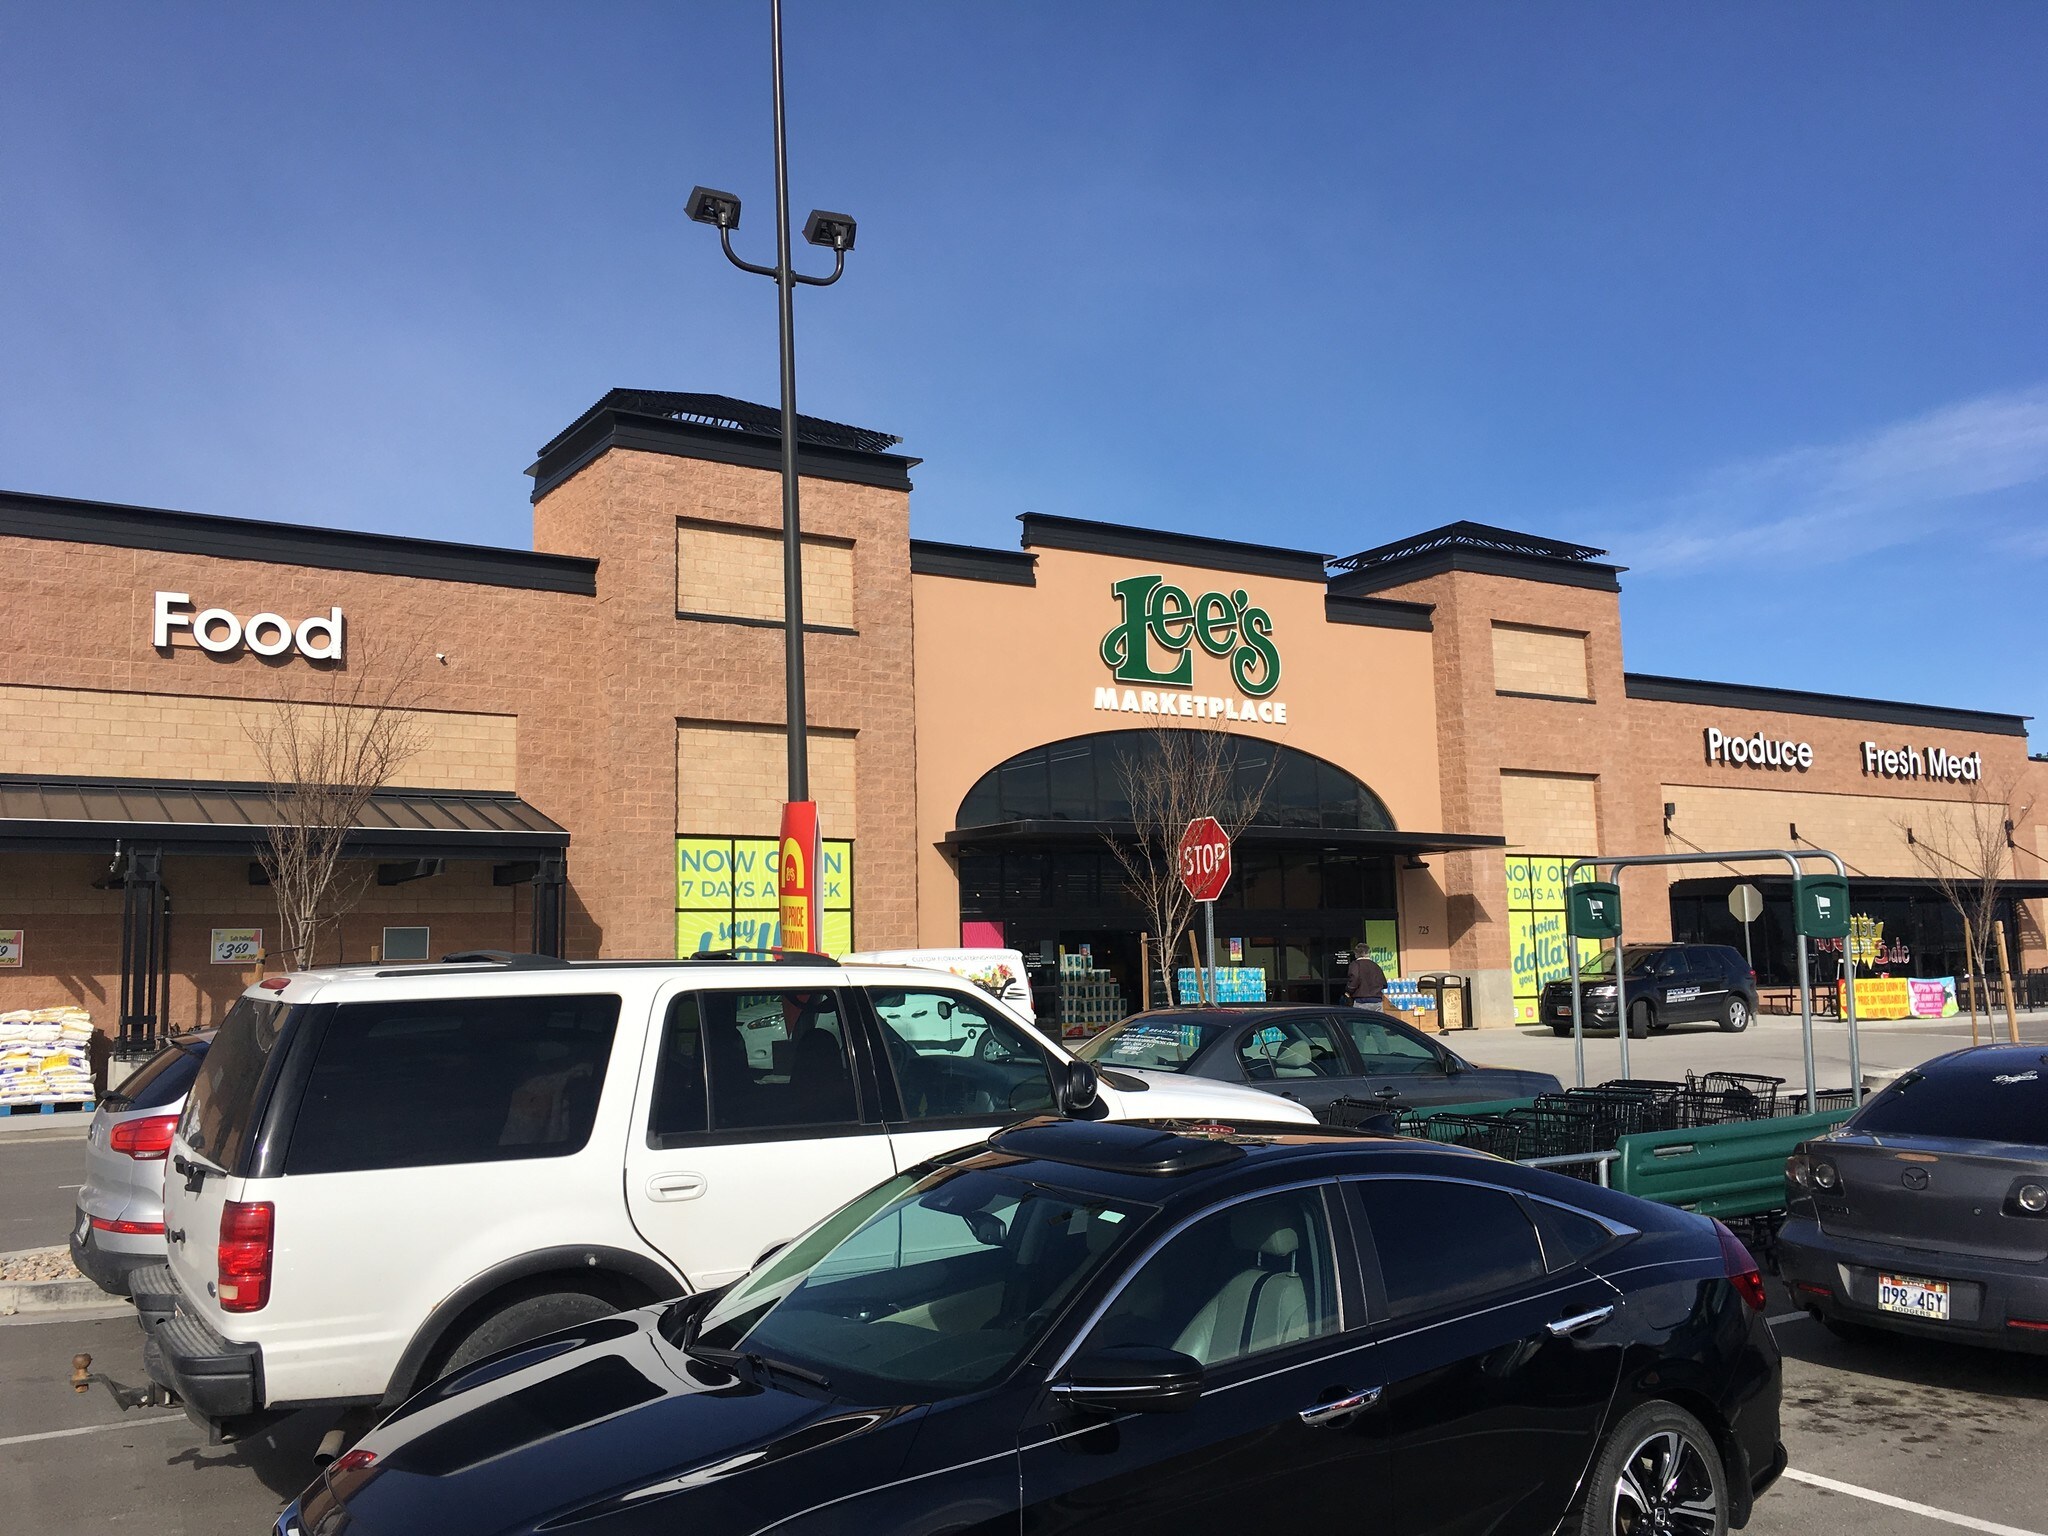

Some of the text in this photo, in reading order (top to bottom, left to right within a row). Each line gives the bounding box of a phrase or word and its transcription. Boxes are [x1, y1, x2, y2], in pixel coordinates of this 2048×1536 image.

[154, 591, 343, 661] Food
[1101, 574, 1282, 696] Lee's
[1094, 686, 1288, 725] MARKETPLACE
[1707, 727, 1814, 769] Produce
[1863, 741, 1982, 781] Fresh Meat
[681, 849, 842, 874] NOW ON
[1184, 842, 1226, 876] STOP
[1506, 865, 1542, 881] NOW
[681, 881, 694, 897] 7
[701, 881, 755, 897] DAYS
[761, 881, 776, 898] A
[1513, 887, 1544, 900] DAYS
[1546, 888, 1555, 900] A
[718, 919, 759, 942] say
[1418, 925, 1430, 935] 725
[1521, 915, 1560, 939] 1 point
[1850, 921, 1877, 937] ASE
[1875, 936, 1911, 965] Sale
[1518, 974, 1534, 988] you
[1149, 1028, 1196, 1037] BEACHBODY
[1882, 1286, 1943, 1312] D98 4GY
[1891, 1305, 1931, 1317] DODGERS
